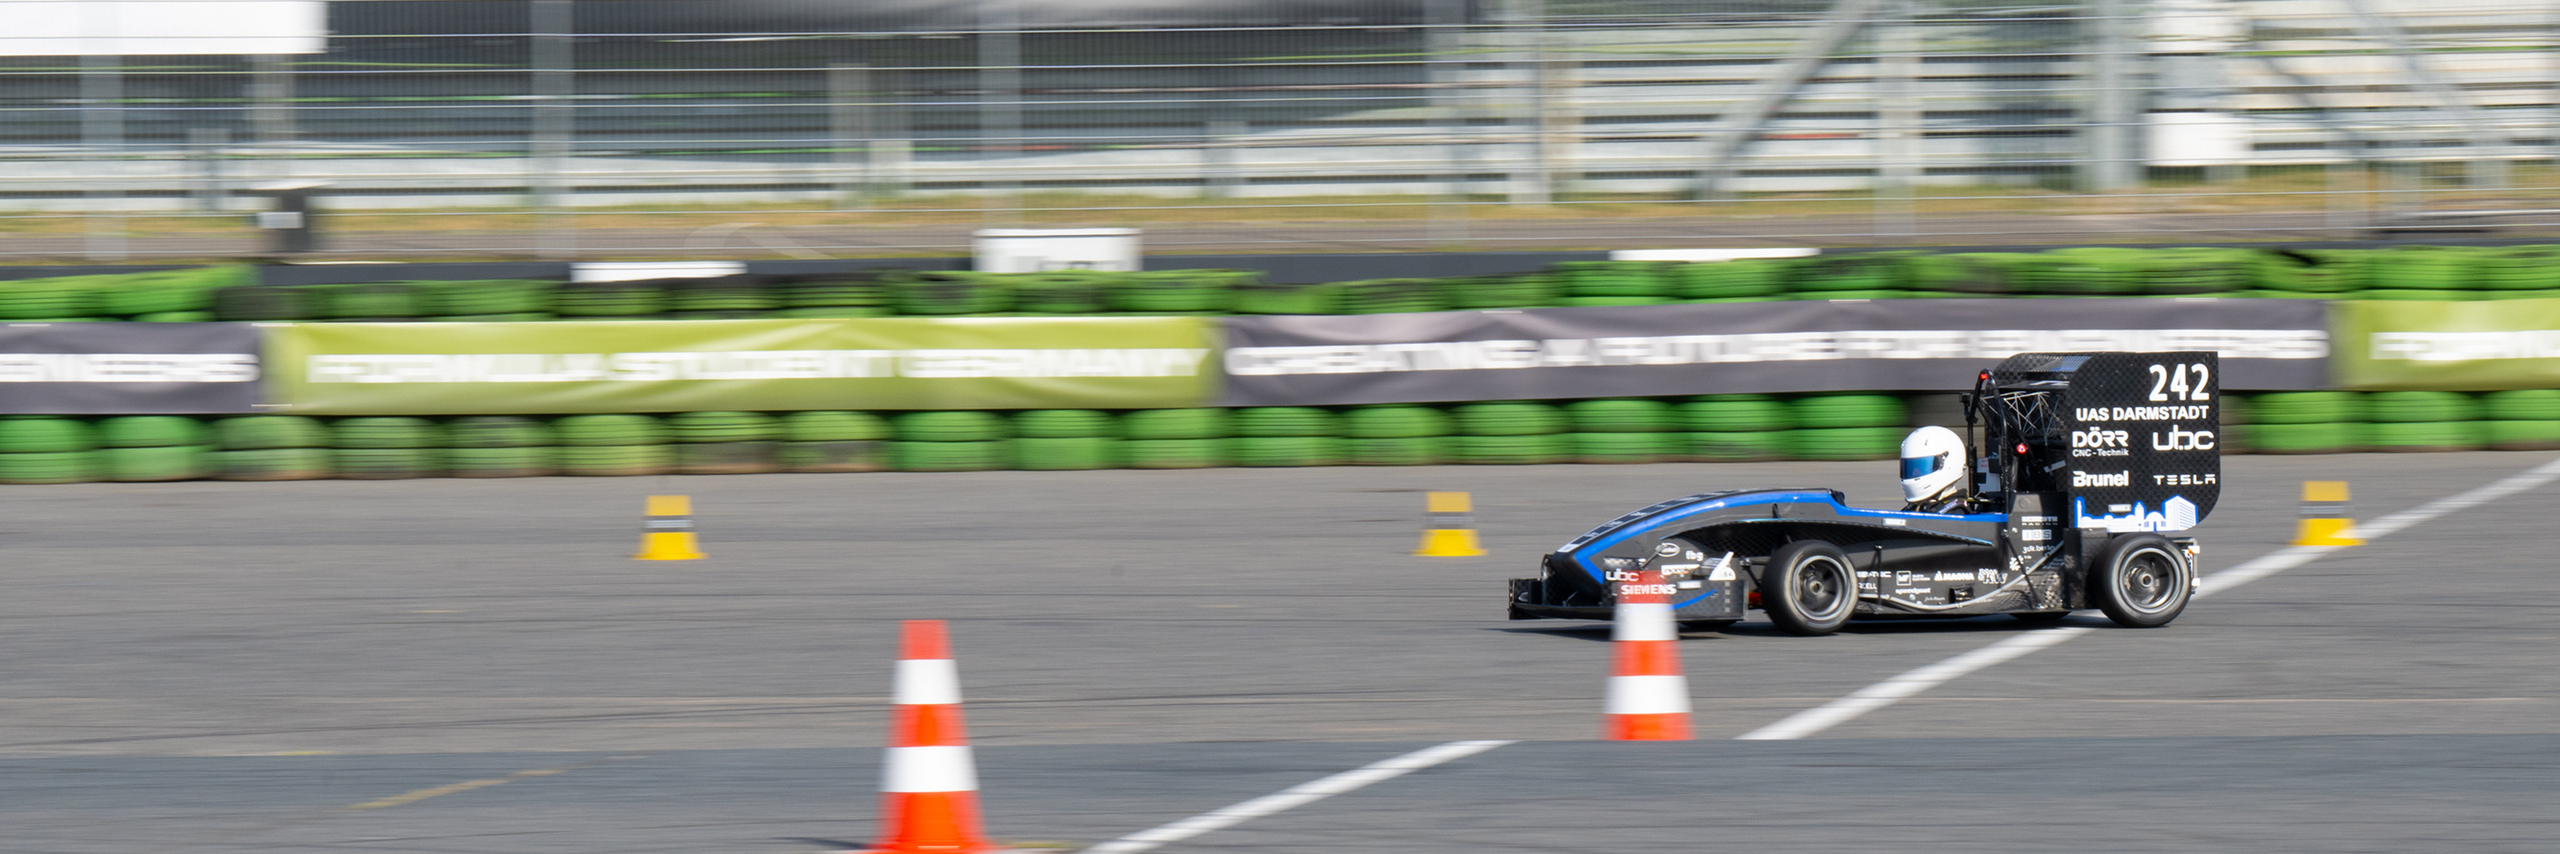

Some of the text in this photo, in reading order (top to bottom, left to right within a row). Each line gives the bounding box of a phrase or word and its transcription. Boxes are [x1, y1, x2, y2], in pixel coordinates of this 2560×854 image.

[2149, 363, 2210, 401] 242
[2076, 405, 2210, 421] UAS DARMSTADT
[2071, 427, 2129, 448] DÖRR
[2152, 424, 2215, 450] ubc
[2073, 470, 2129, 487] Brunel
[2153, 474, 2216, 485] TESLA
[1605, 568, 1639, 582] ubc
[1620, 584, 1677, 595] SIEMENS
